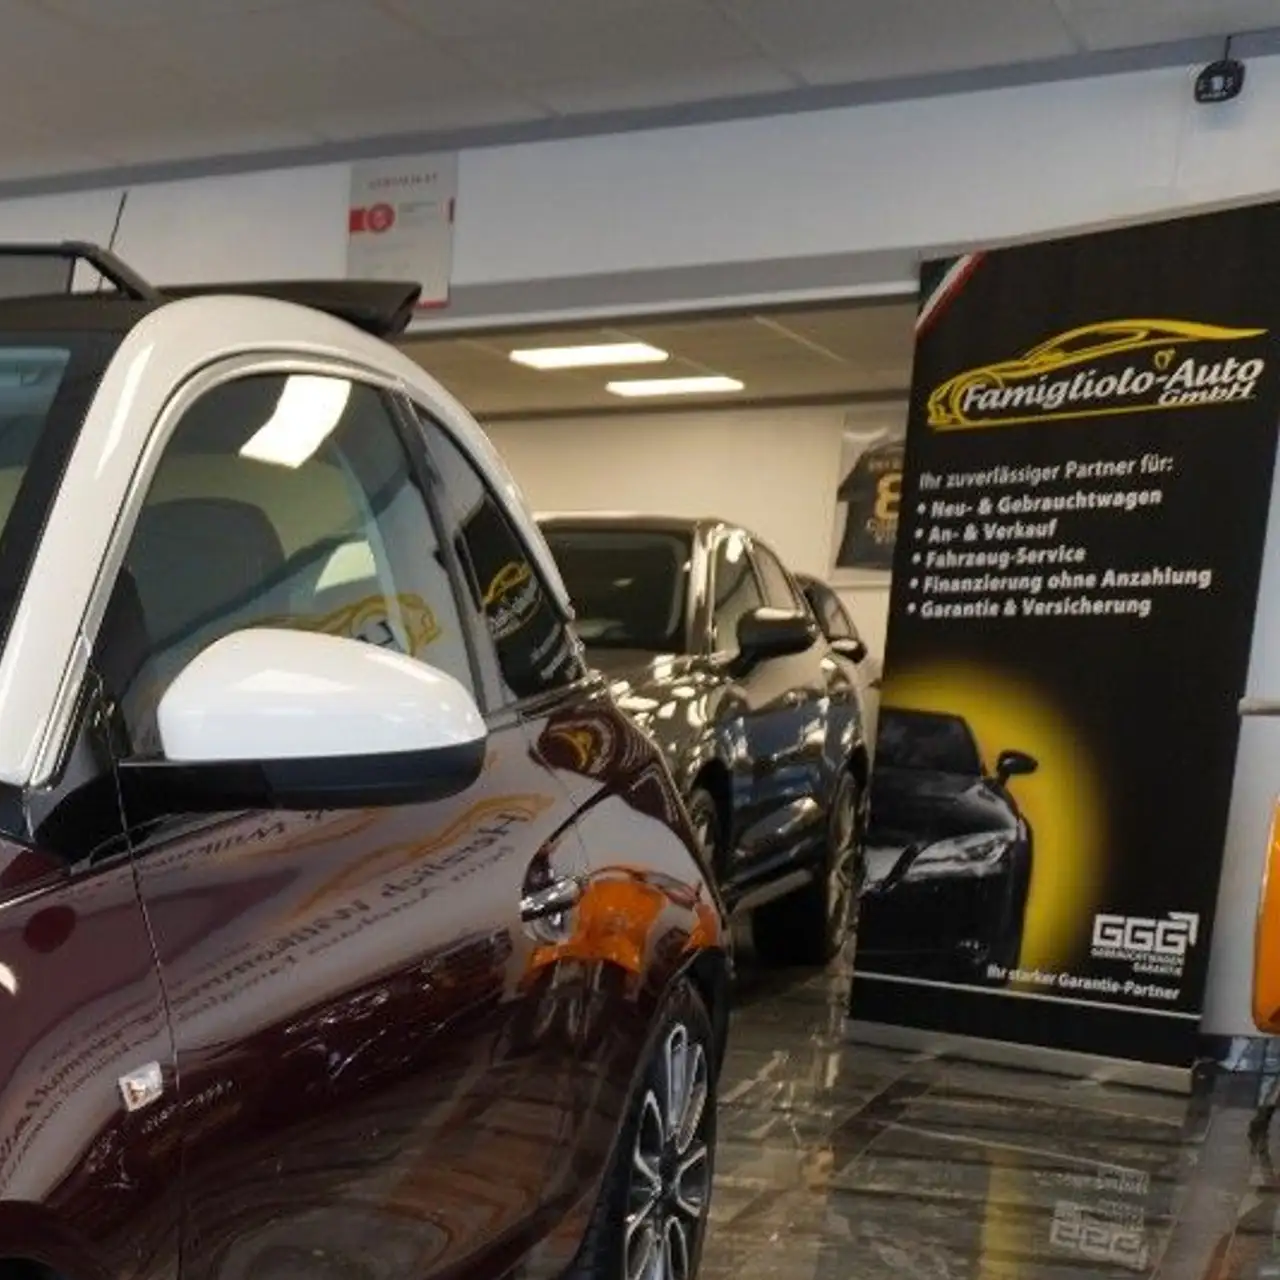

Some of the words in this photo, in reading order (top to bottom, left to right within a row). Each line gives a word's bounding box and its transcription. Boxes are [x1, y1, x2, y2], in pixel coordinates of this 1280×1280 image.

[1157, 382, 1256, 406] GmbH
[919, 472, 942, 490] Ihr
[946, 464, 1059, 488] zuverlässiger
[1064, 459, 1136, 479] Partner
[1140, 454, 1174, 474] für:
[931, 501, 973, 519] Neu-
[977, 498, 993, 516] &
[997, 487, 1163, 514] Gebrauchtwagen
[928, 526, 959, 544] An-
[963, 524, 979, 542] &
[984, 518, 1058, 540] Verkauf
[926, 544, 1087, 570] Fahrzeug-Service
[922, 573, 1044, 595] Finanzierung
[1047, 570, 1098, 590] ohne
[1100, 566, 1213, 590] Anzahlung
[920, 599, 1000, 619] Garantie
[1003, 599, 1017, 617] &
[1021, 596, 1153, 618] Versicherung
[1092, 912, 1194, 954] GGG
[987, 964, 1007, 981] Ihr
[1008, 969, 1058, 986] starker
[1058, 972, 1181, 1000] Garantie-Partner
